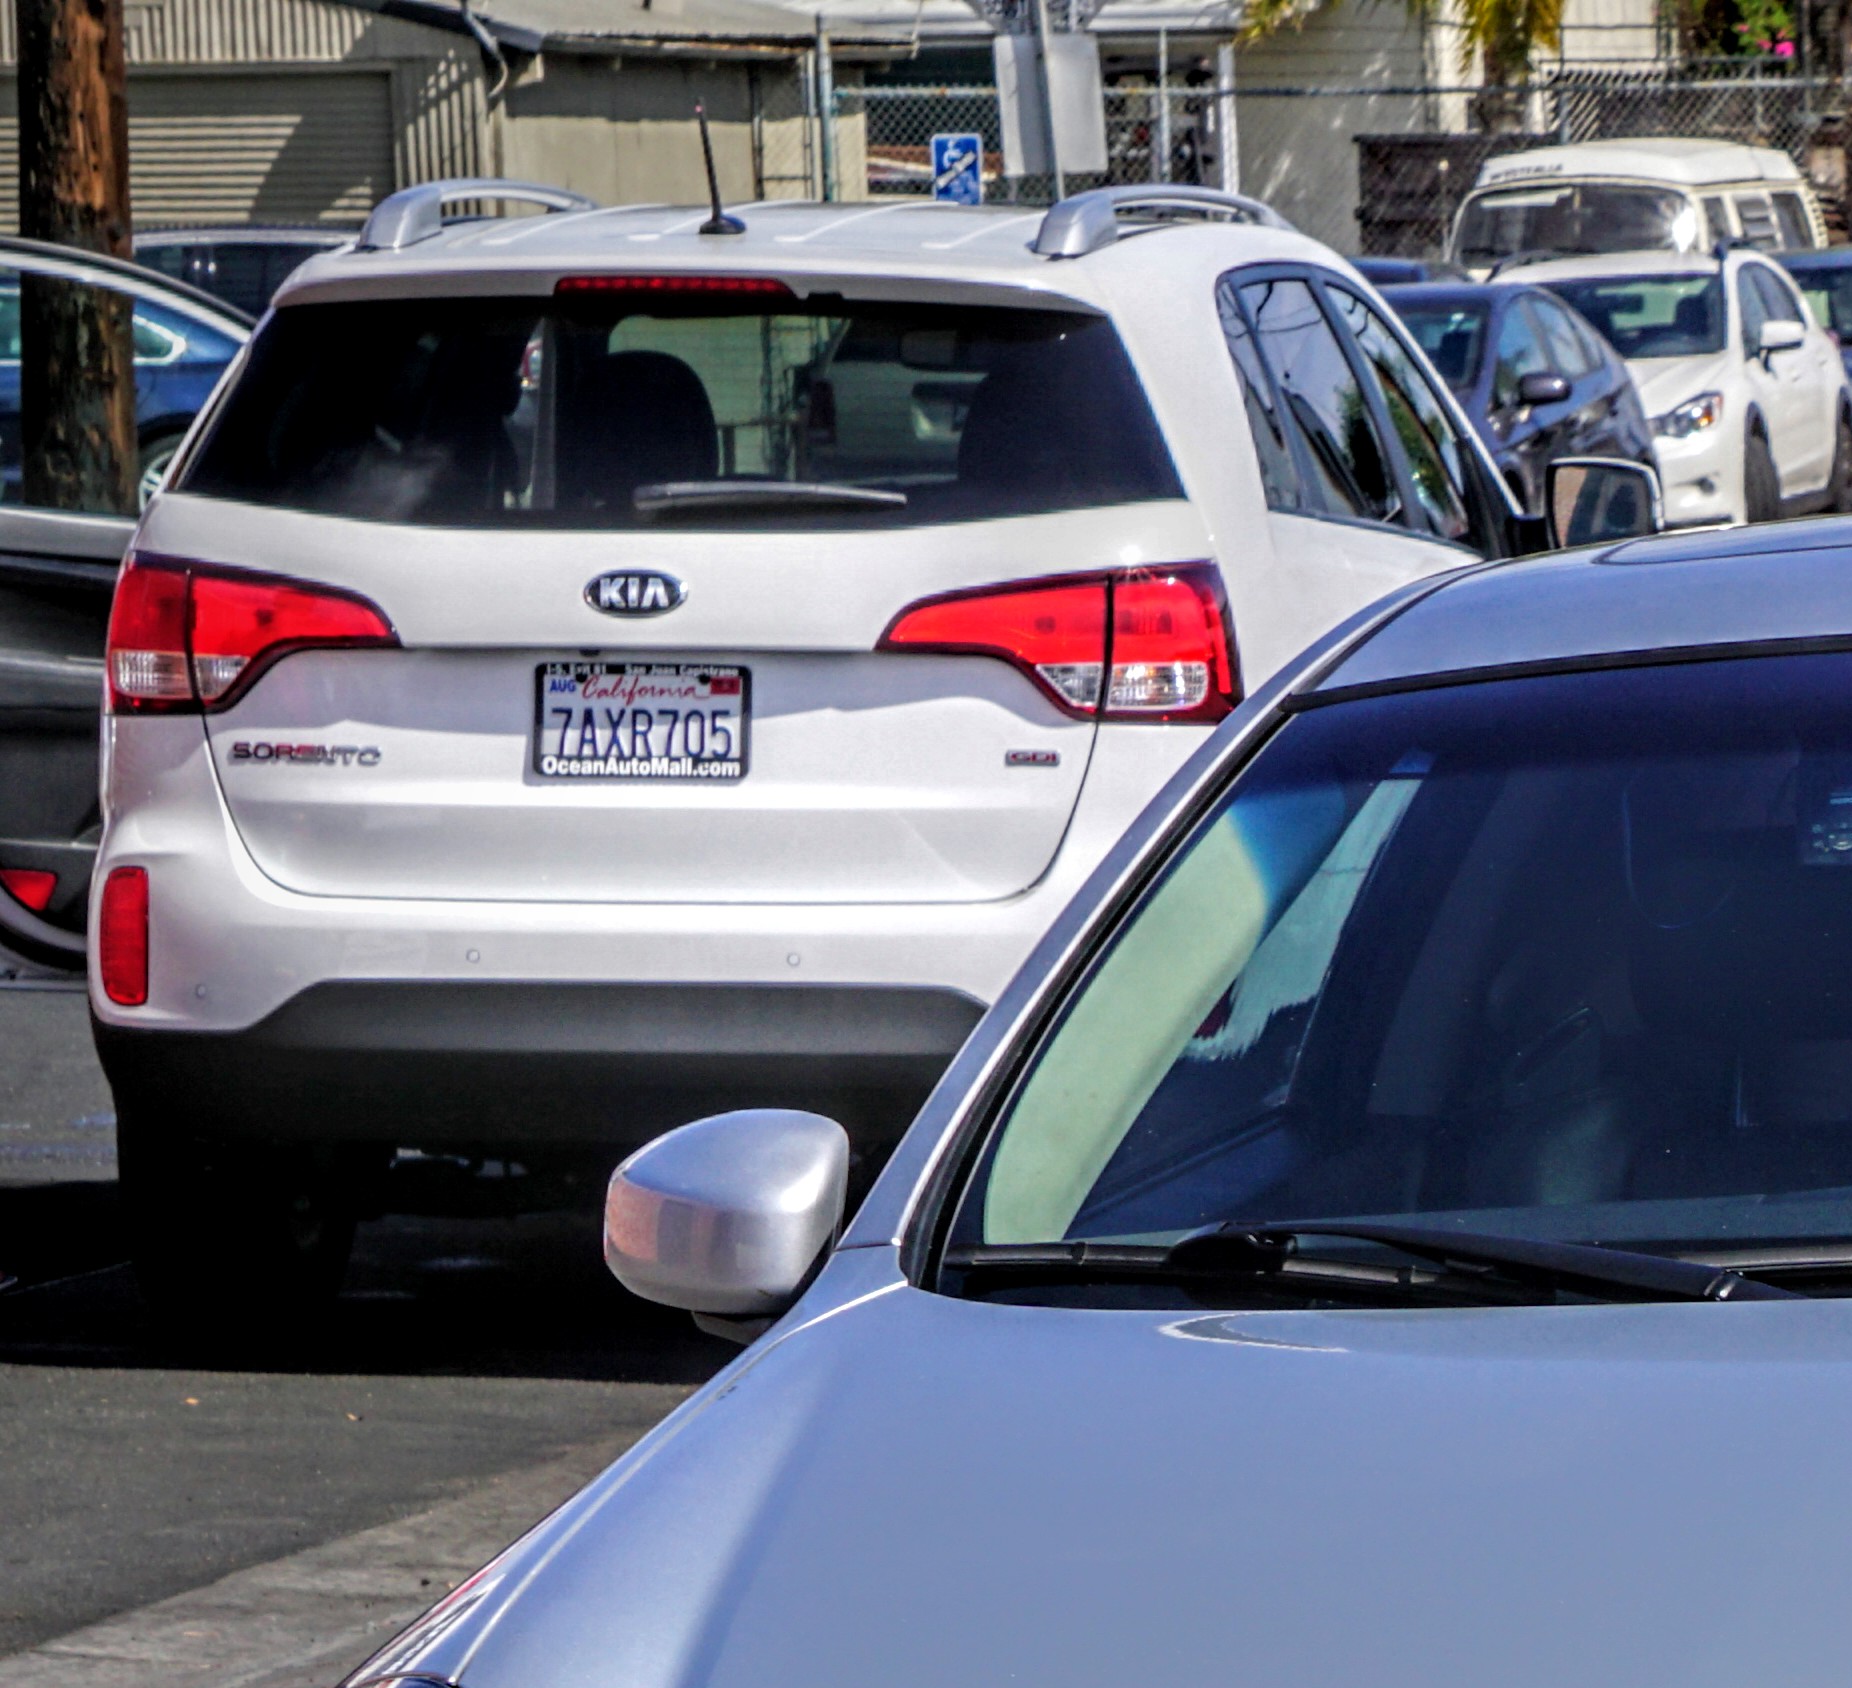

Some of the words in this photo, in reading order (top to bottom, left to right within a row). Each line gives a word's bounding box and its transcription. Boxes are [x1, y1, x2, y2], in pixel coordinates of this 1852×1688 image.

[599, 577, 669, 608] KIA
[549, 679, 577, 693] AUG
[581, 674, 709, 706] California
[551, 707, 732, 758] 7AXR705
[541, 756, 741, 777] OceanAutoMall.com
